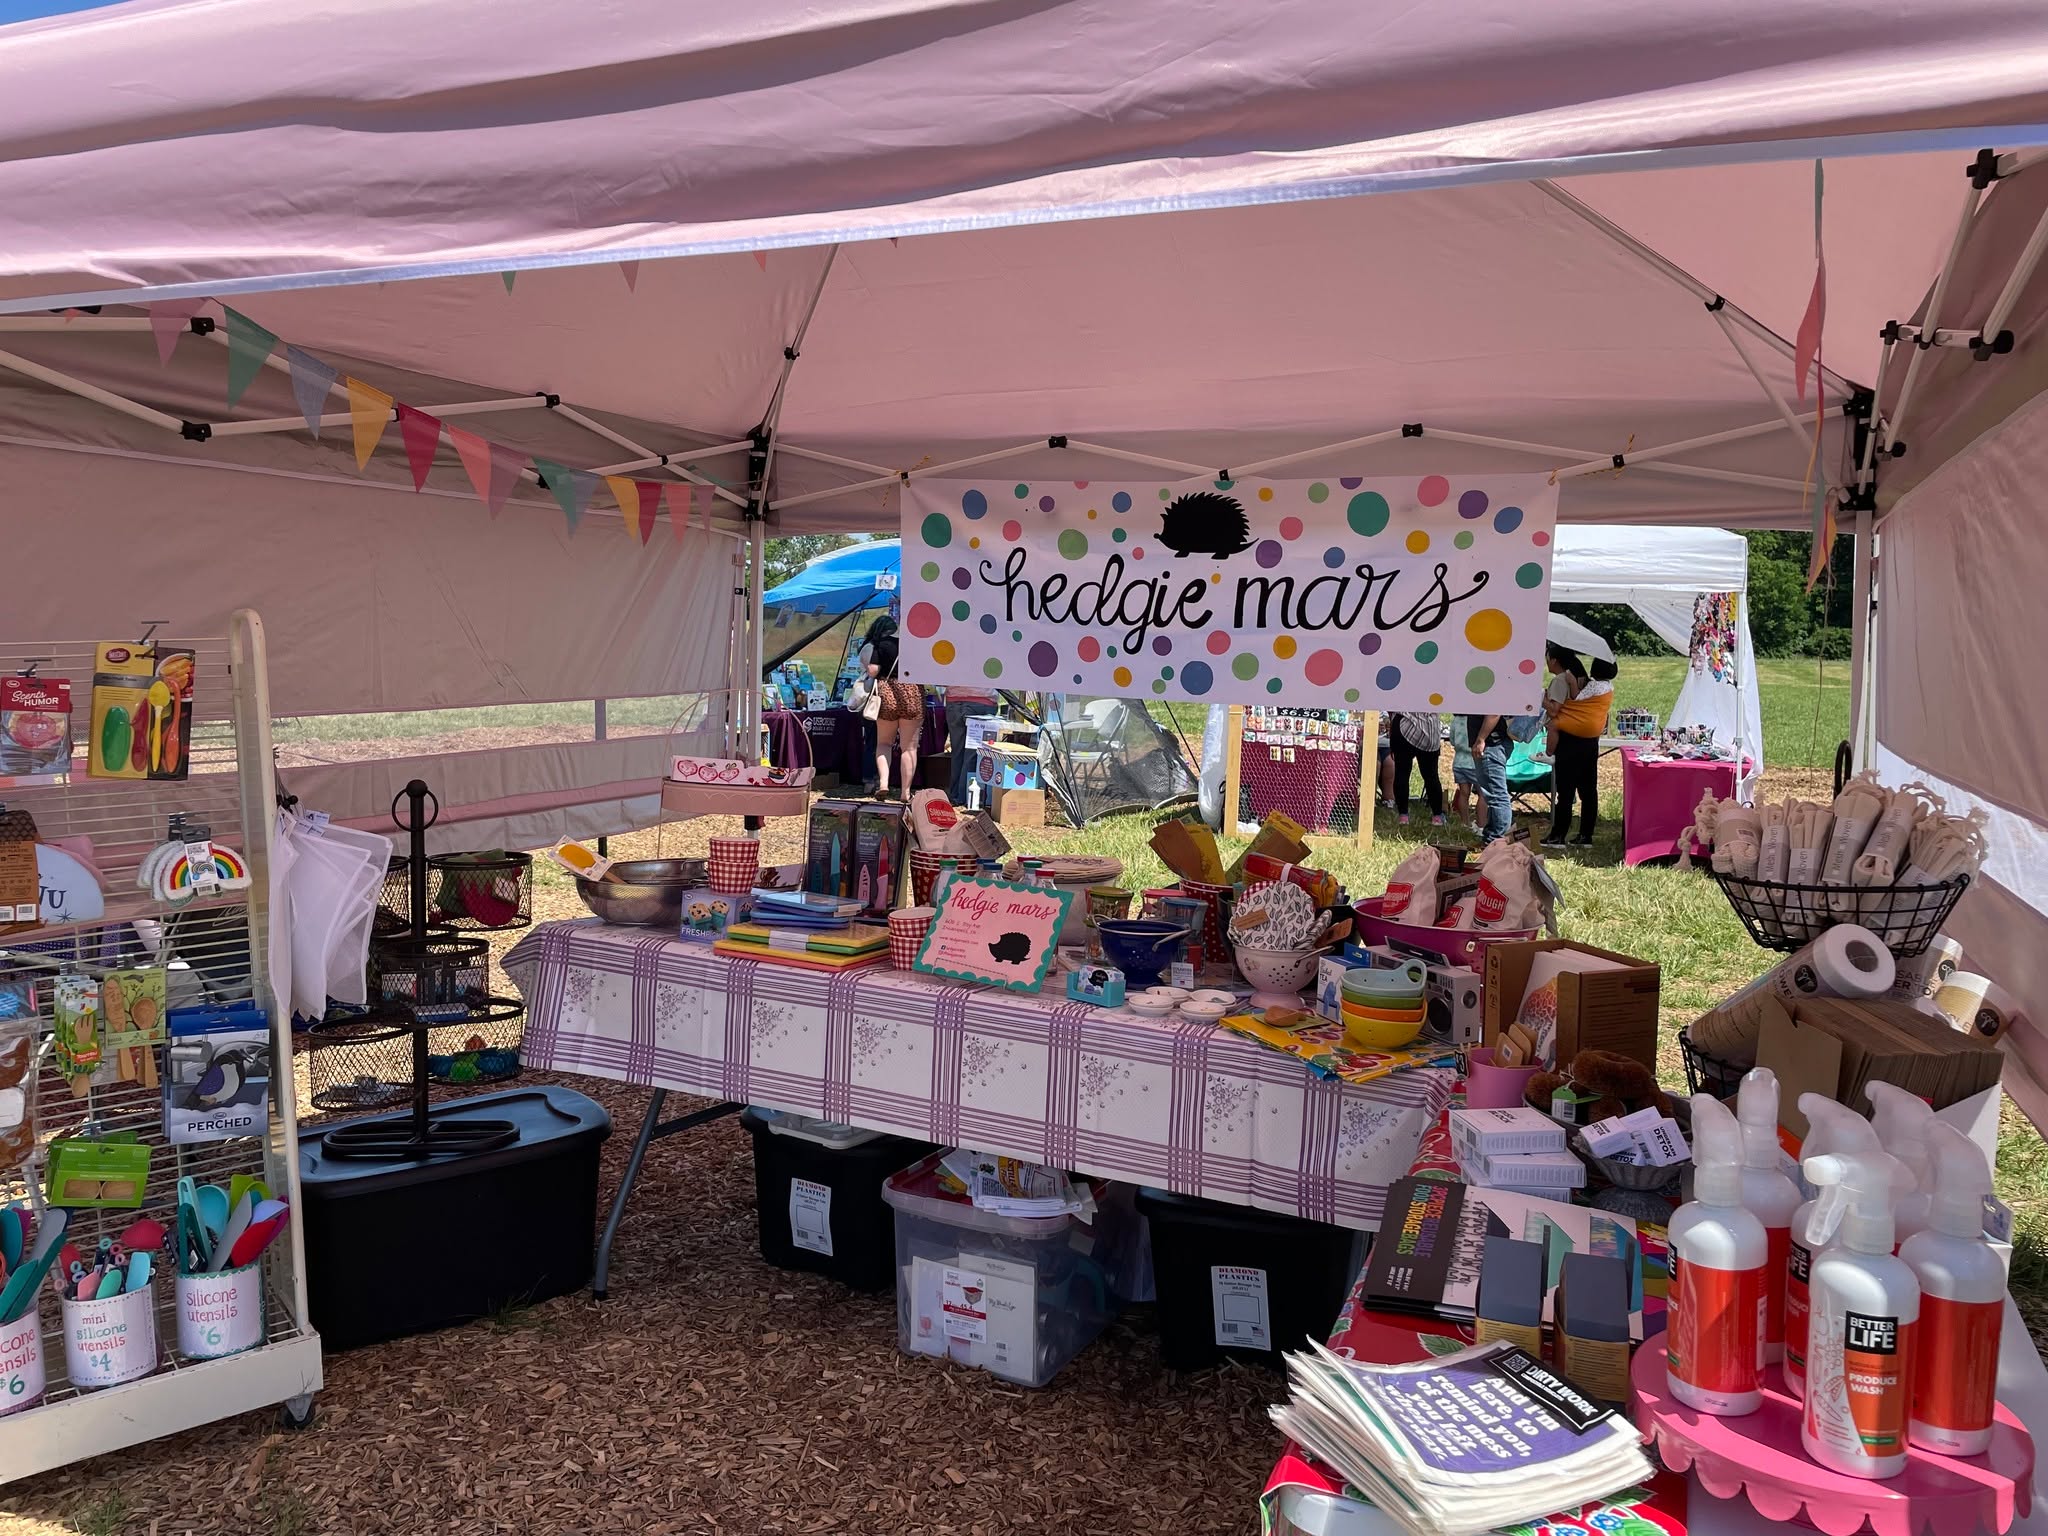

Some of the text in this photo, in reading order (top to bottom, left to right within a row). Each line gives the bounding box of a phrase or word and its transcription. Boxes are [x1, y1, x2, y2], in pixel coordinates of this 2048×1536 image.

[979, 547, 1490, 655] hedgie mars
[11, 690, 48, 703] Scents
[24, 697, 59, 707] HUMOR
[1281, 709, 1320, 718] $6.50
[1766, 827, 1778, 873] Mesh Woven
[1833, 820, 1853, 872] Mesh Woven
[1798, 850, 1808, 876] Woven
[951, 888, 1057, 920] hedgie mars
[187, 1117, 252, 1132] PERCHED
[1653, 1128, 1672, 1159] DETOX
[1659, 1126, 1677, 1157] UNDERARM
[796, 1186, 826, 1198] PLASTICS
[797, 1180, 826, 1192] DIAMOND
[1411, 1183, 1433, 1203] FOOD
[1401, 1201, 1427, 1235] STORAGE
[1396, 1233, 1418, 1256] BAGS
[1413, 1217, 1441, 1259] REUSABLE
[1219, 1267, 1259, 1276] DIAMOND
[1219, 1274, 1260, 1282] PLASTICS
[82, 1313, 107, 1325] mini
[188, 1303, 238, 1323] utensils
[1850, 1316, 1894, 1331] BETTER
[77, 1335, 126, 1352] utensils
[199, 1326, 222, 1346] $6
[1849, 1330, 1895, 1349] LIFE
[90, 1353, 112, 1372] $4
[1848, 1373, 1897, 1386] PRODUCE
[1851, 1384, 1884, 1395] WASH
[1527, 1365, 1599, 1417] DIRTY WORK
[1468, 1381, 1540, 1436] here, to
[1485, 1377, 1561, 1431] And I'm
[1384, 1384, 1466, 1458] when you
[1405, 1392, 1478, 1451] you left
[1415, 1380, 1513, 1459] of the mess
[1431, 1374, 1533, 1458] remind you,
[1399, 1410, 1451, 1462] away.
